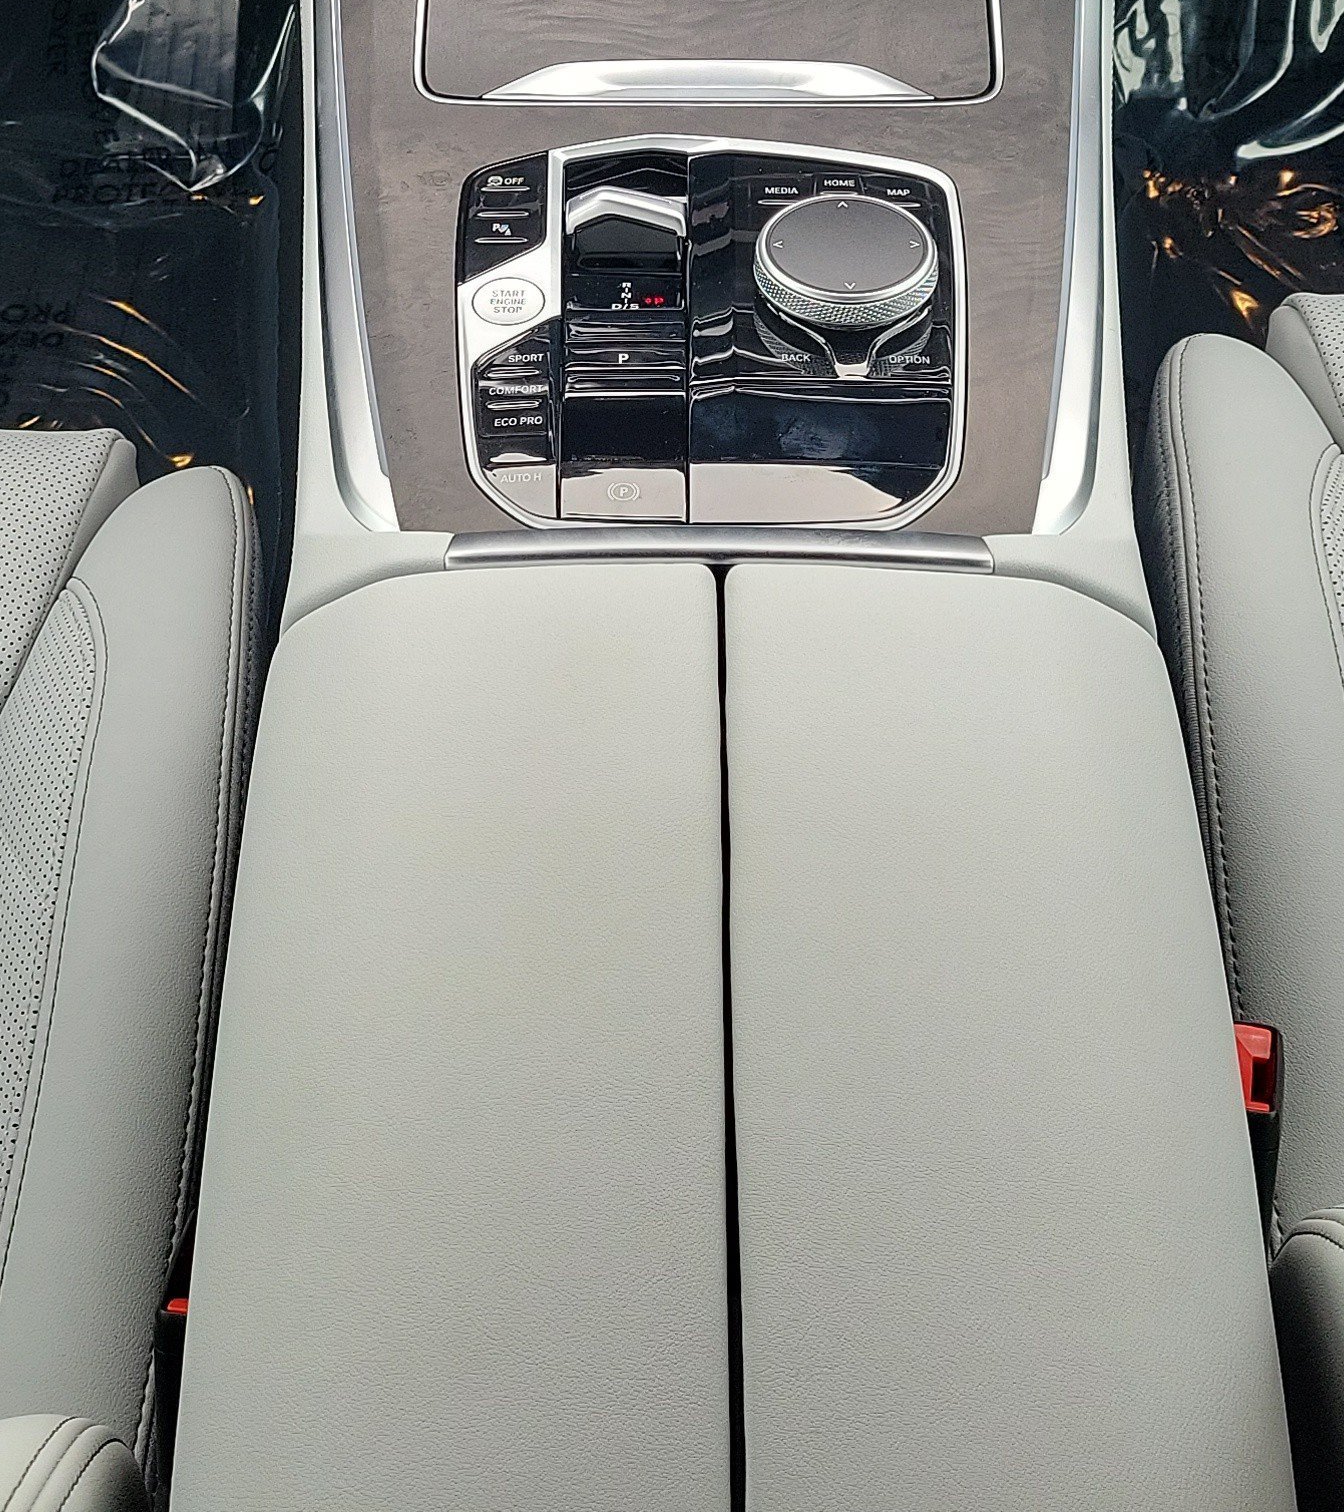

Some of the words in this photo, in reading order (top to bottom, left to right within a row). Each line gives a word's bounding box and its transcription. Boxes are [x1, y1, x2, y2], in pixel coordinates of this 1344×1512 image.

[504, 176, 525, 186] OFF
[823, 179, 856, 187] HOME
[764, 187, 799, 195] MEDIA
[886, 188, 911, 196] MAP
[492, 289, 526, 298] START
[490, 298, 527, 306] ENGINE
[493, 306, 523, 314] STOP
[508, 353, 545, 363] SPORT
[618, 353, 630, 364] P
[781, 353, 812, 363] BACK
[888, 354, 931, 365] OPTION
[488, 384, 544, 396] COMFORT
[494, 417, 517, 427] ECO
[519, 415, 543, 426] PRO
[500, 472, 531, 484] AUTO
